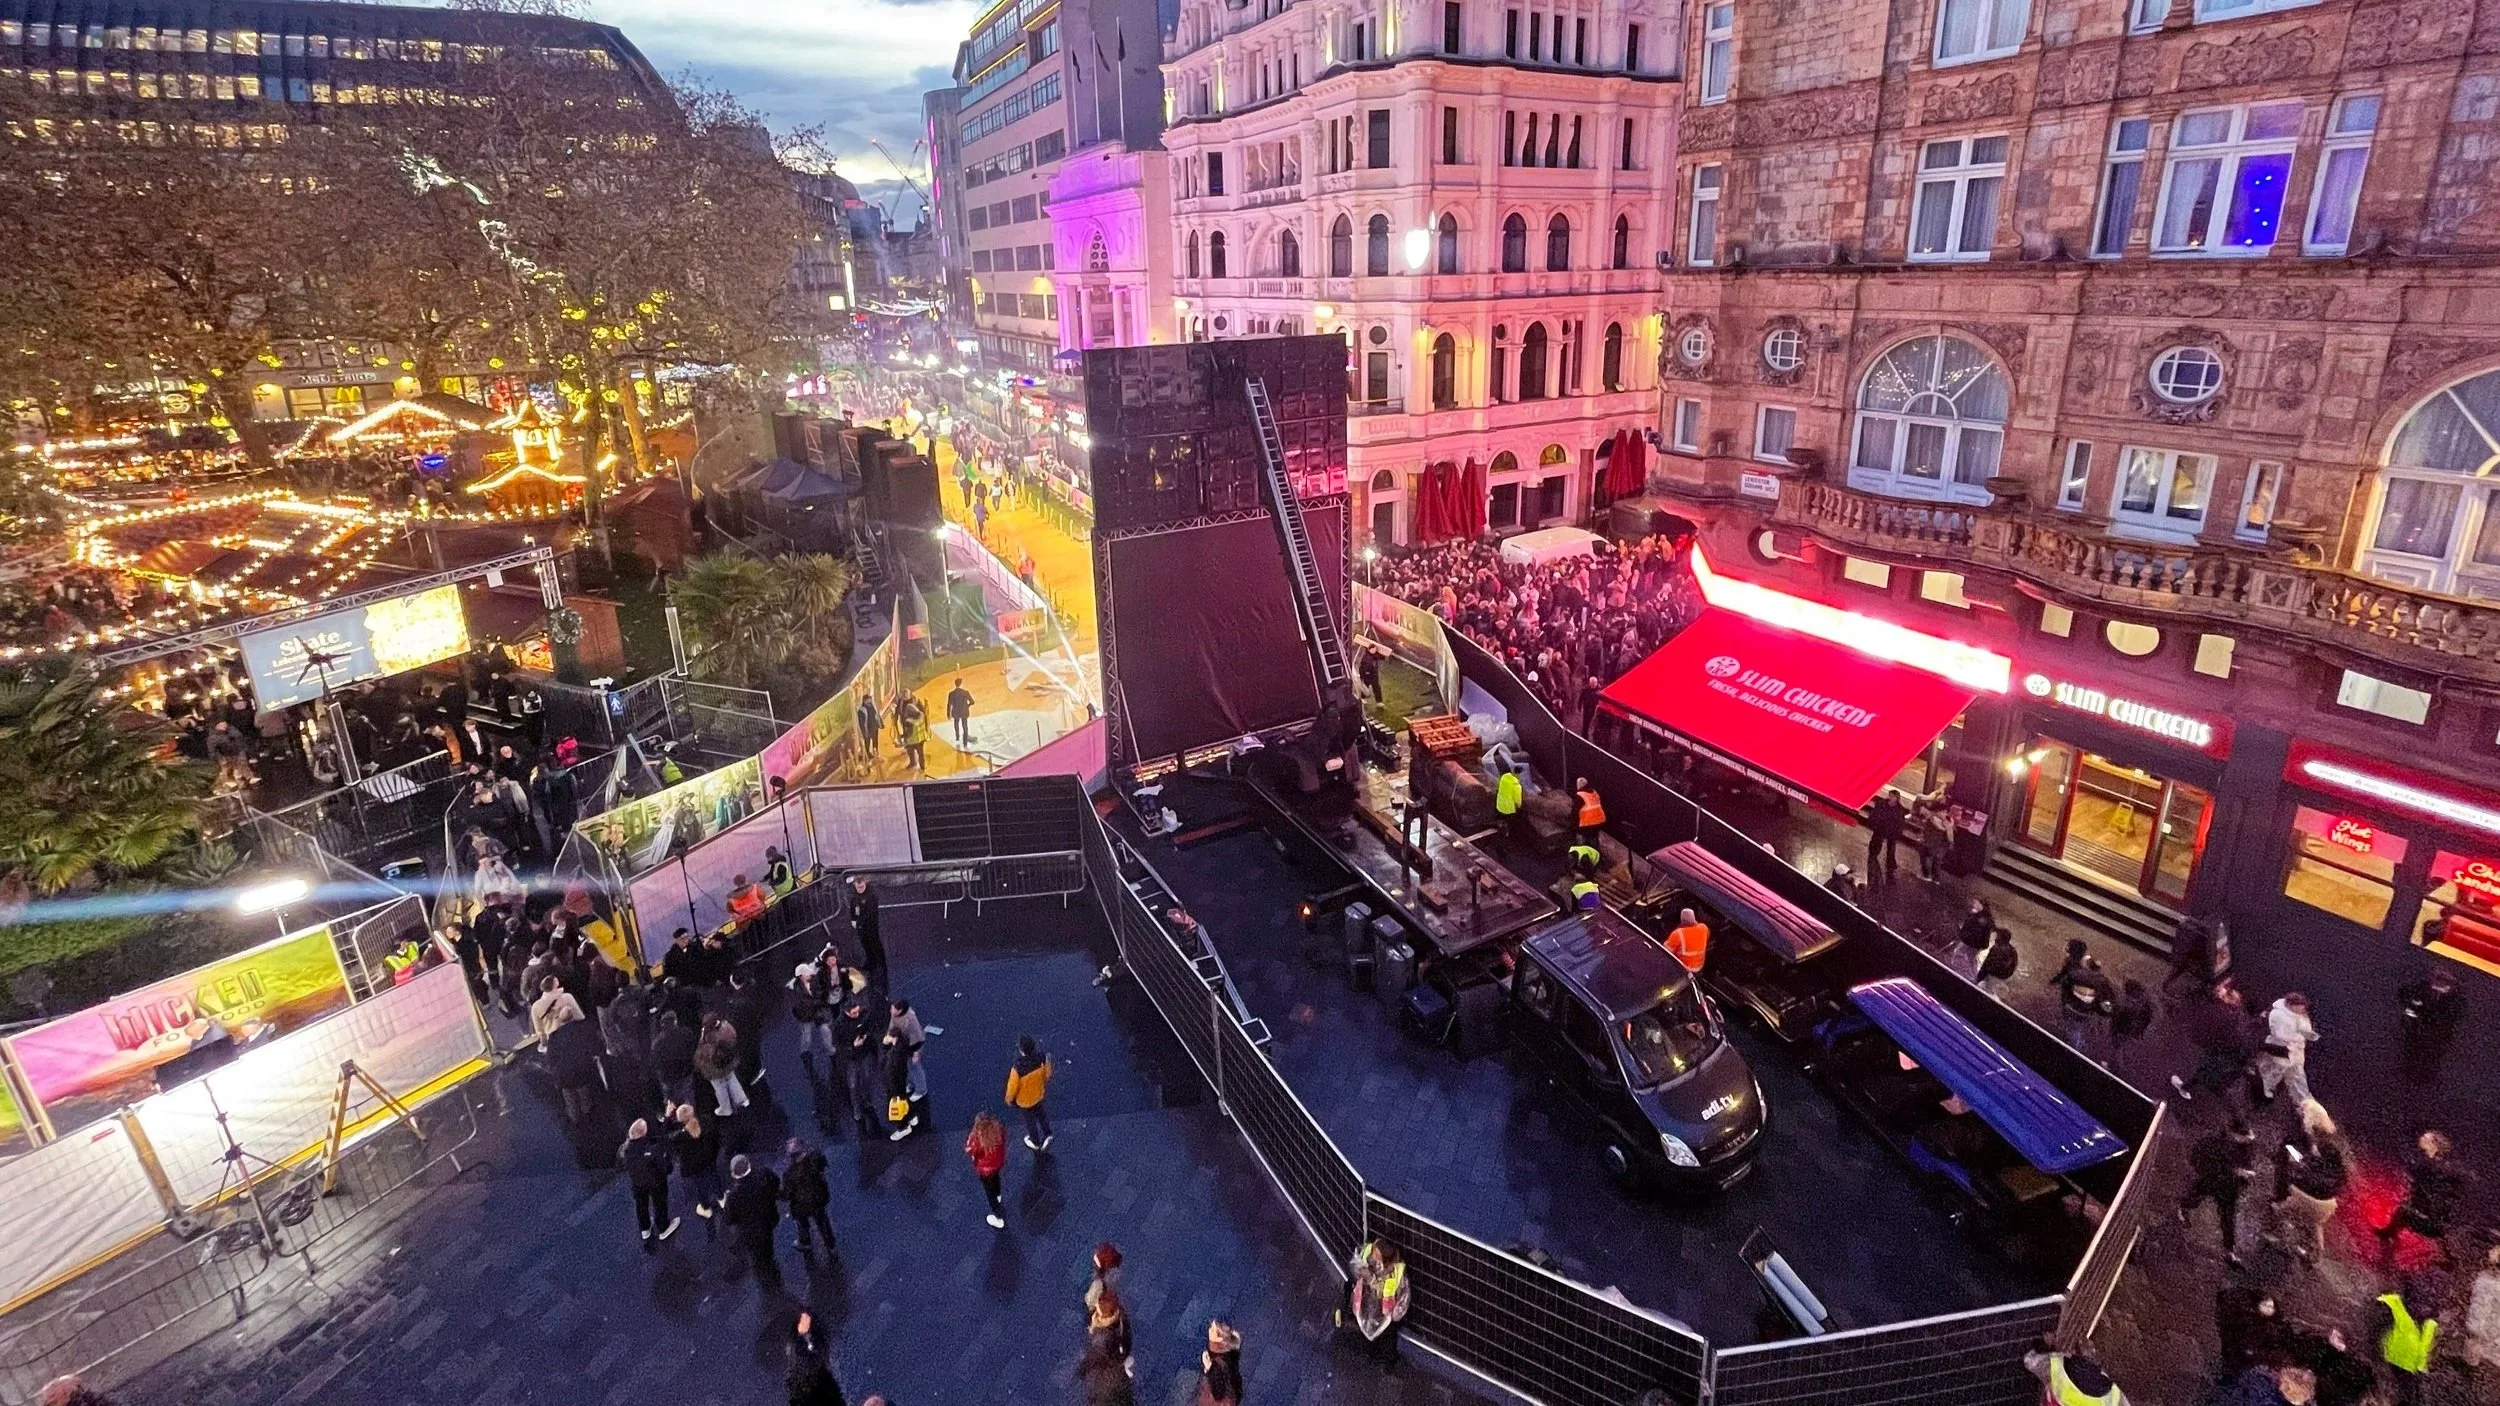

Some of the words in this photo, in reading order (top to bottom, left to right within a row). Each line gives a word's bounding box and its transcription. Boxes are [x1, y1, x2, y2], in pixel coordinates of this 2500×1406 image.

[1736, 669, 1786, 696] SLIM
[1783, 687, 1877, 728] CHICKENS
[1738, 692, 1790, 717] DELICIOUS
[1788, 711, 1834, 733] CHICKEN
[2055, 683, 2105, 715] SLIM
[2108, 699, 2212, 747] CHICKENS
[2331, 830, 2371, 853] Wings
[2335, 819, 2373, 839] Hot
[99, 968, 267, 1050] WICKED
[151, 1031, 181, 1048] FO
